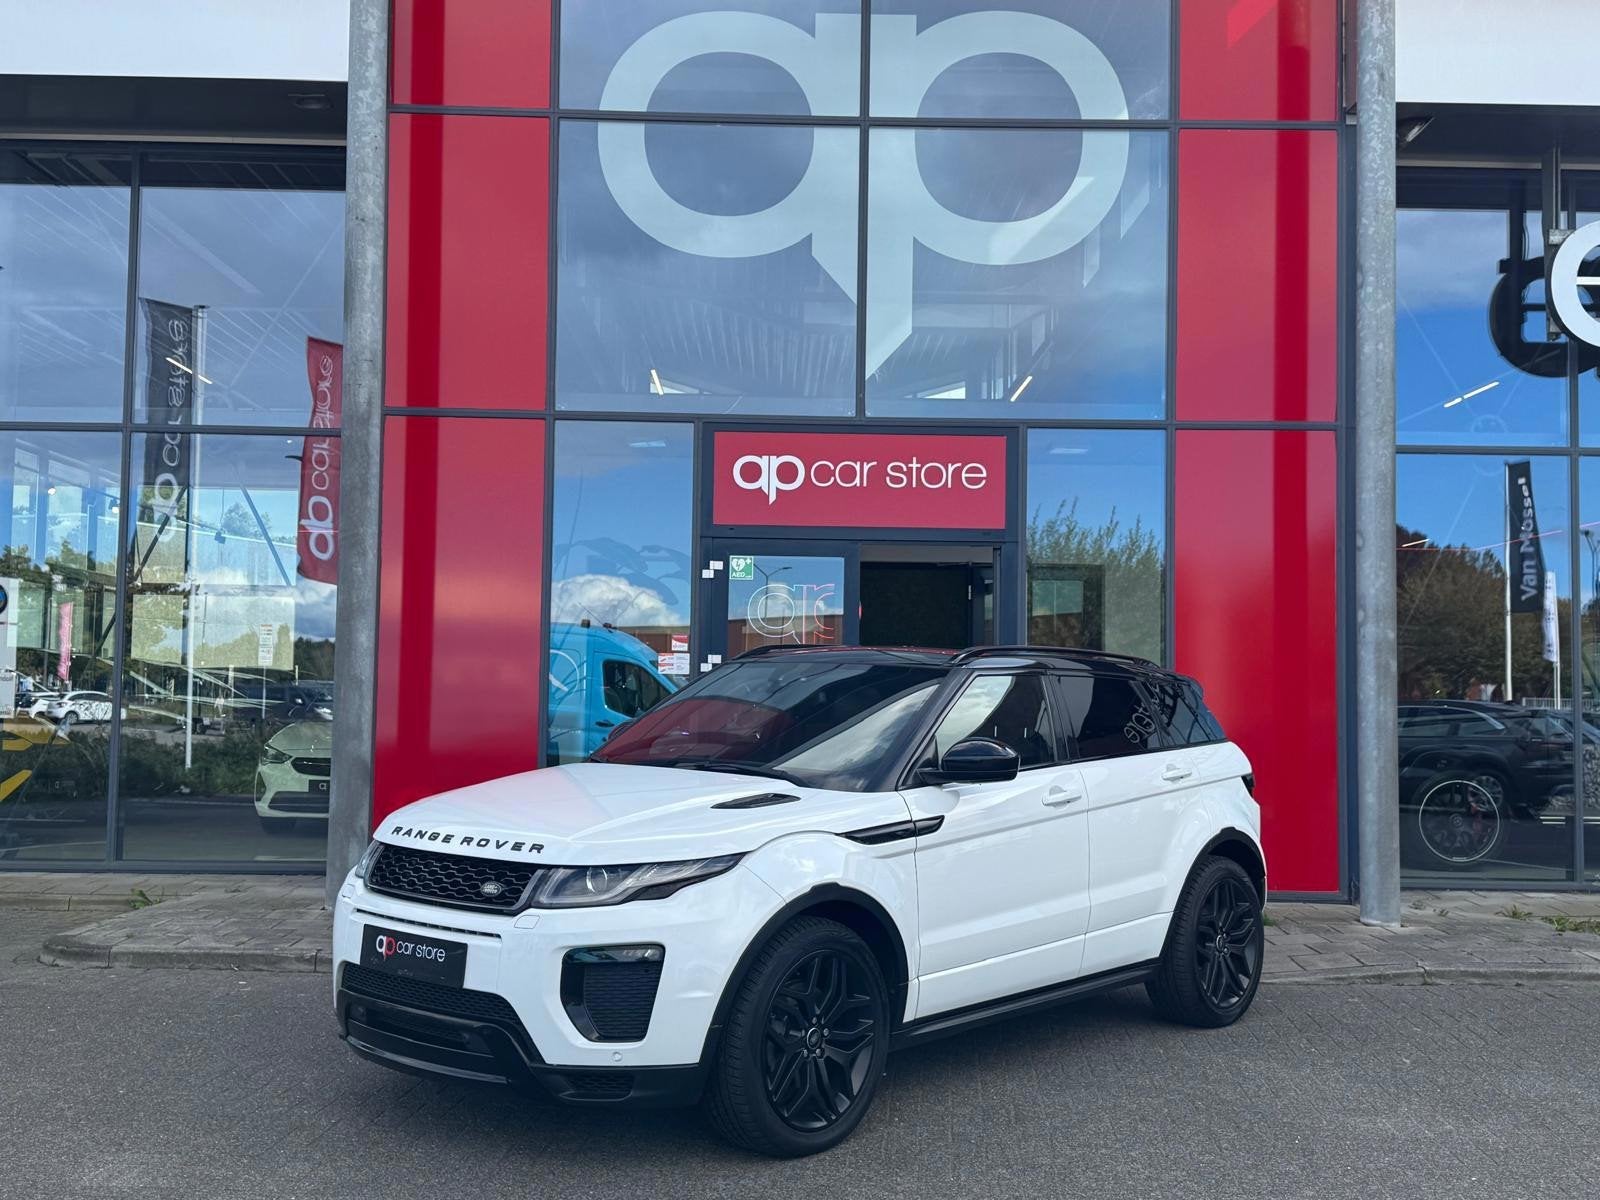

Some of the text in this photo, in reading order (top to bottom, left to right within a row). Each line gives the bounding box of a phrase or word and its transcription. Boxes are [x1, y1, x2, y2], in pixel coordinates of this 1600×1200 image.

[732, 455, 988, 506] ap car store
[1517, 476, 1538, 601] Van Mossel
[391, 825, 545, 854] RANGE ROVER
[375, 934, 446, 962] ap car store
